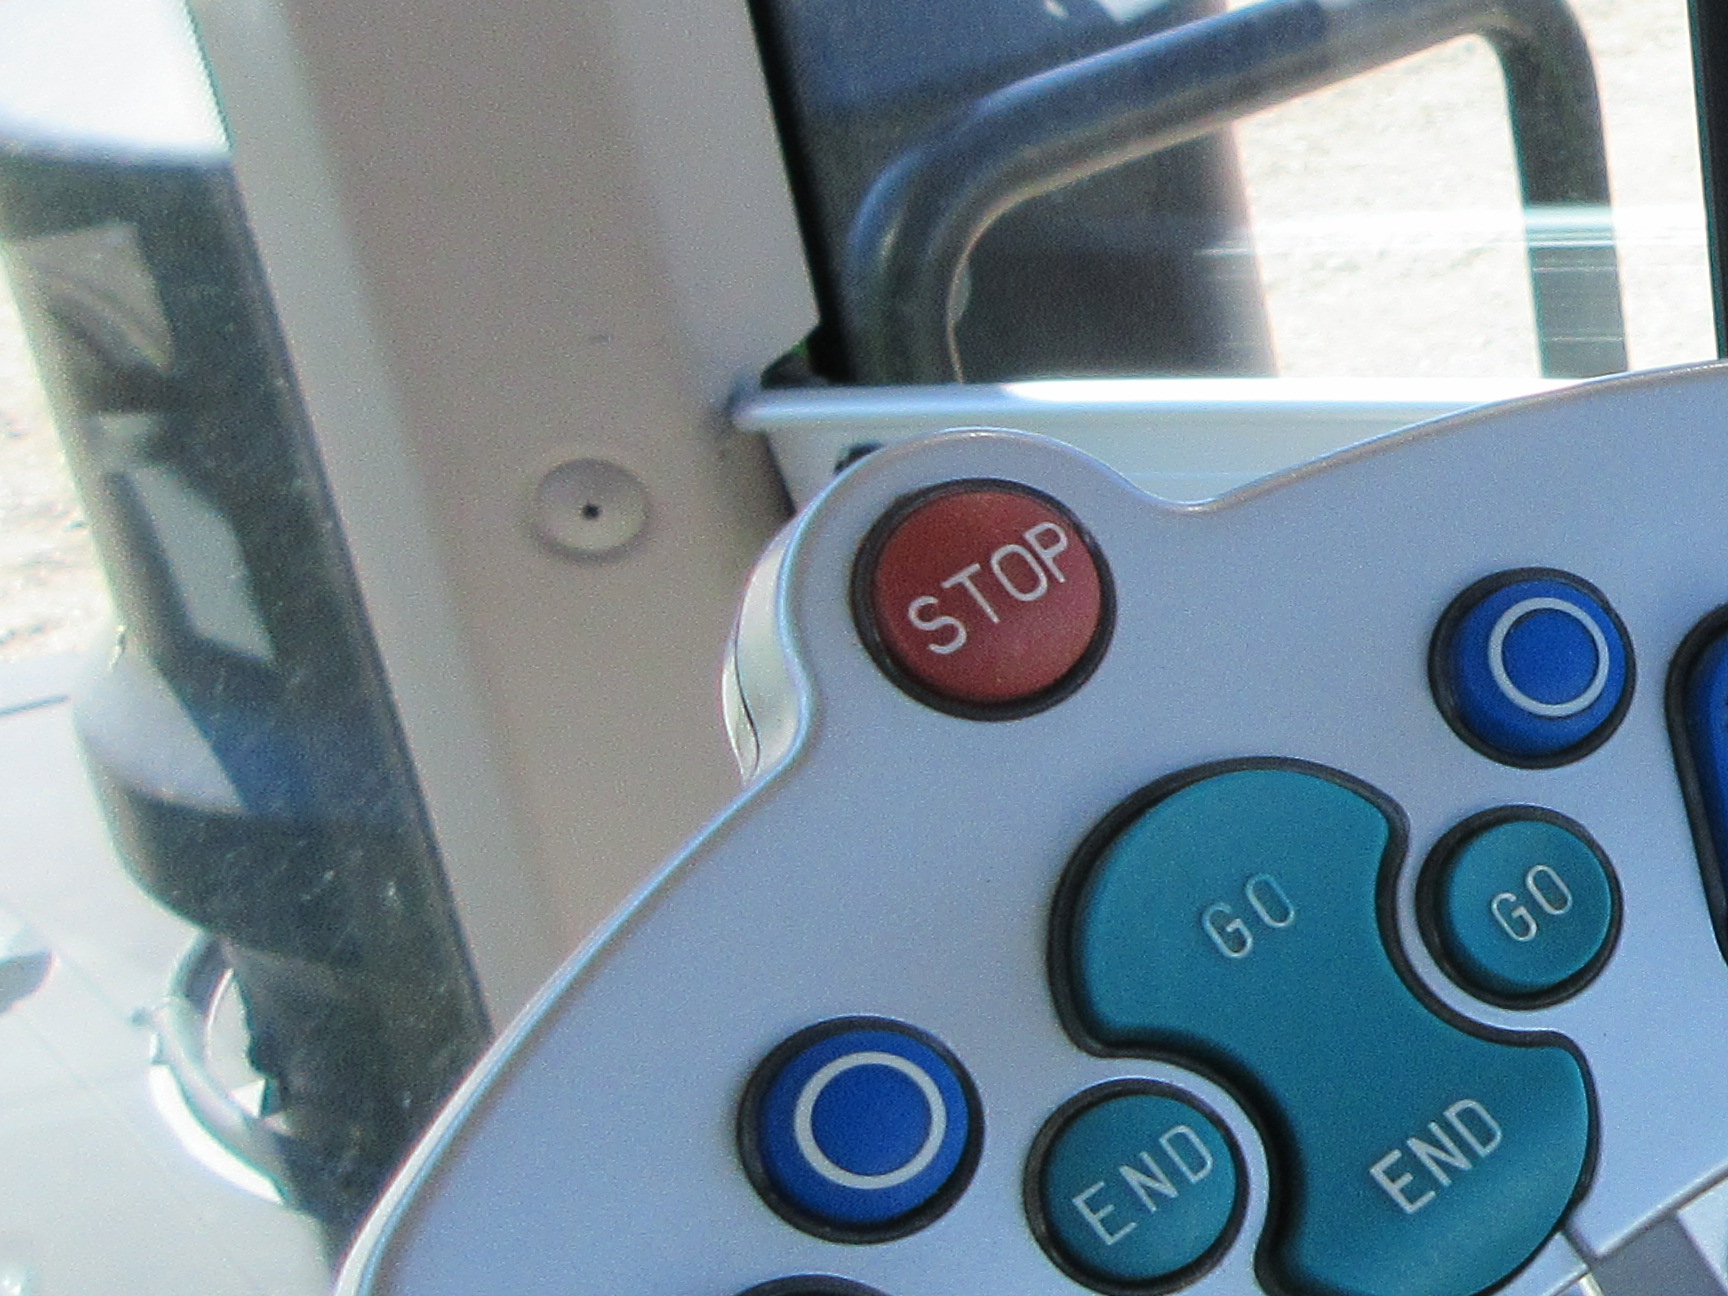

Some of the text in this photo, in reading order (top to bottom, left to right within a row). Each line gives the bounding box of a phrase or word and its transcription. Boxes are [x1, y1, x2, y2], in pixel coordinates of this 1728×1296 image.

[907, 519, 1070, 656] STOP
[1203, 872, 1297, 960] GO
[1489, 864, 1574, 944] GO
[1072, 1124, 1214, 1245] END
[1369, 1098, 1503, 1215] END
